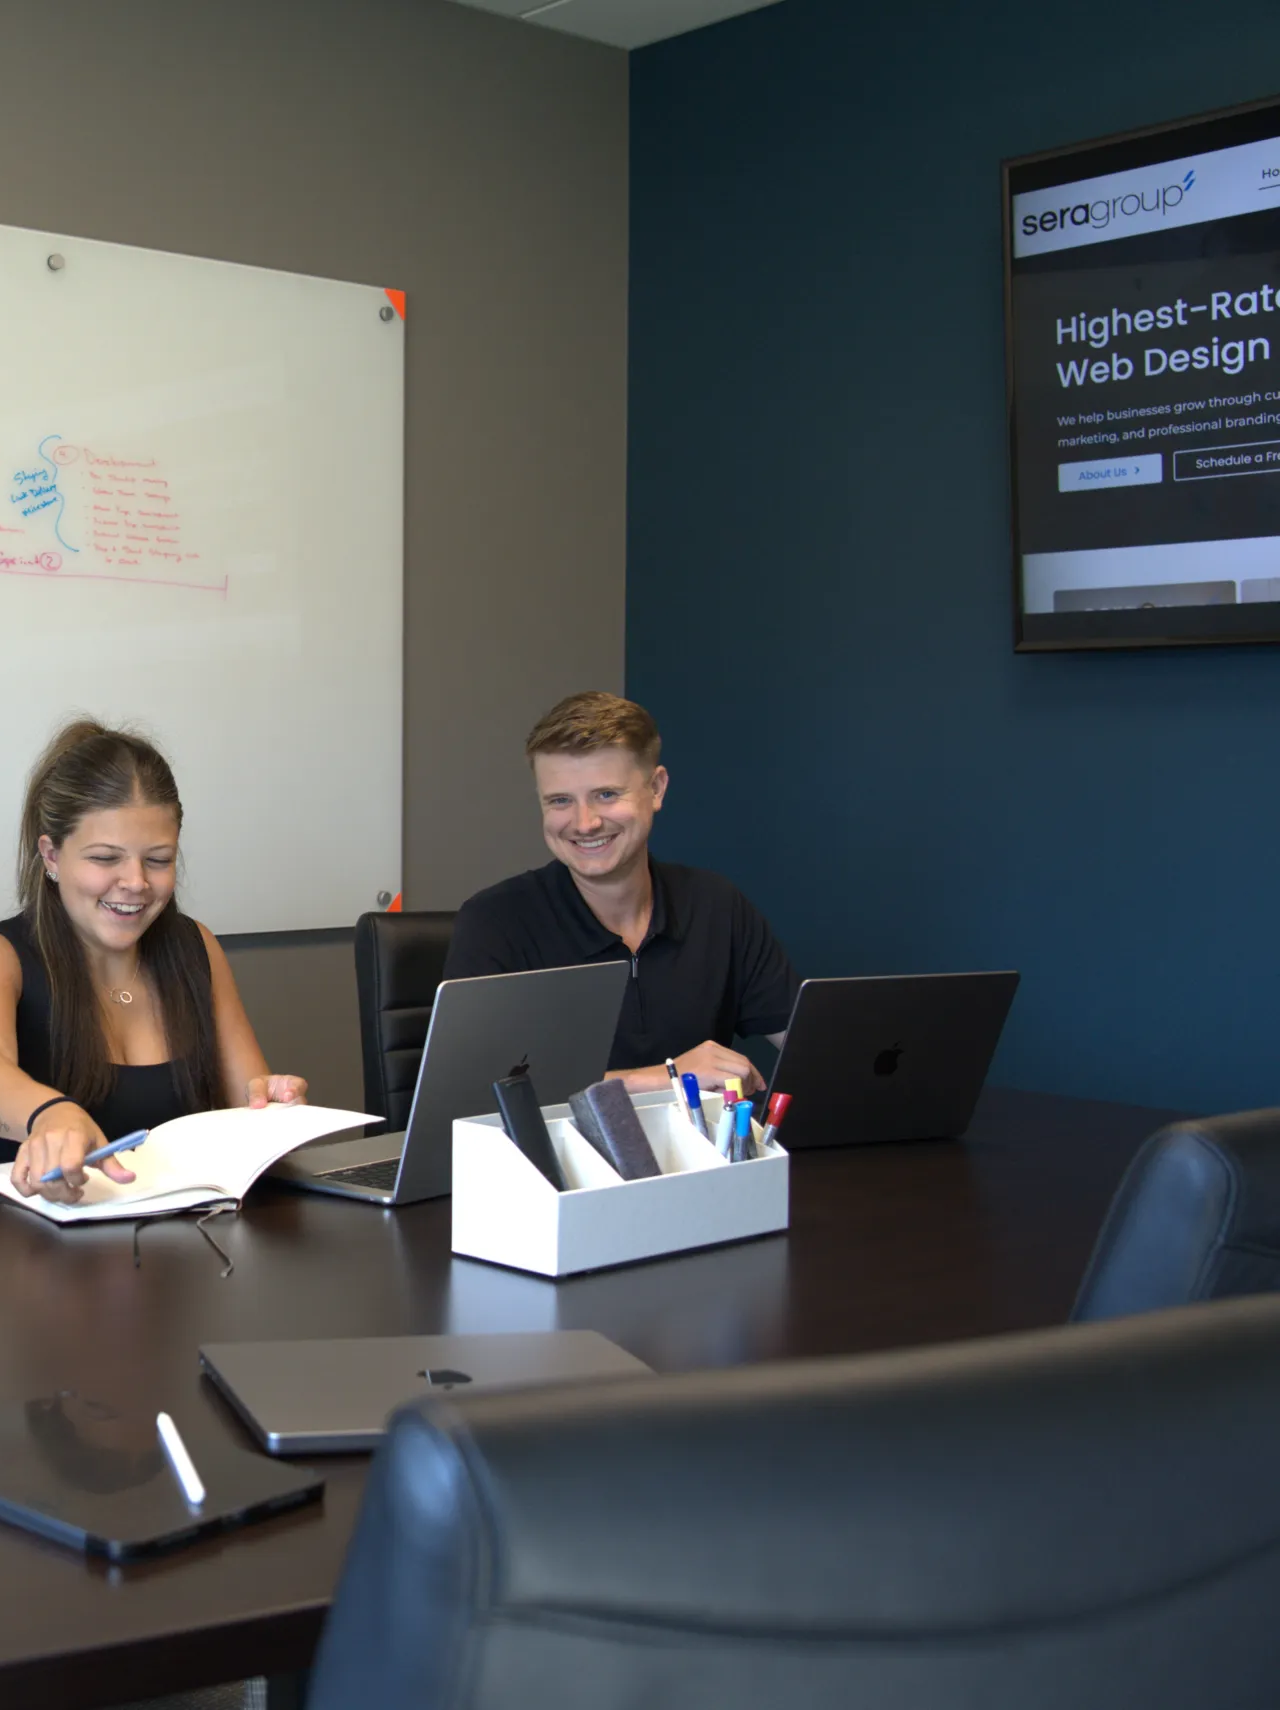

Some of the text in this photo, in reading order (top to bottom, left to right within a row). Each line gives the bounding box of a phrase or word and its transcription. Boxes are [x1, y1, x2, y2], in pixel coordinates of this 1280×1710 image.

[1022, 184, 1183, 236] seragroup
[1056, 337, 1270, 388] Web Design
[1057, 415, 1076, 427] We
[1078, 412, 1104, 425] help
[1107, 405, 1171, 421] businesses
[1173, 400, 1206, 414] grow
[1208, 391, 1261, 407] through
[1058, 430, 1120, 447] marketing,
[1122, 428, 1145, 441] and
[1148, 415, 1222, 439] professional
[1078, 468, 1127, 481] About Us
[1195, 453, 1252, 469] Schedule
[1255, 453, 1263, 463] a
